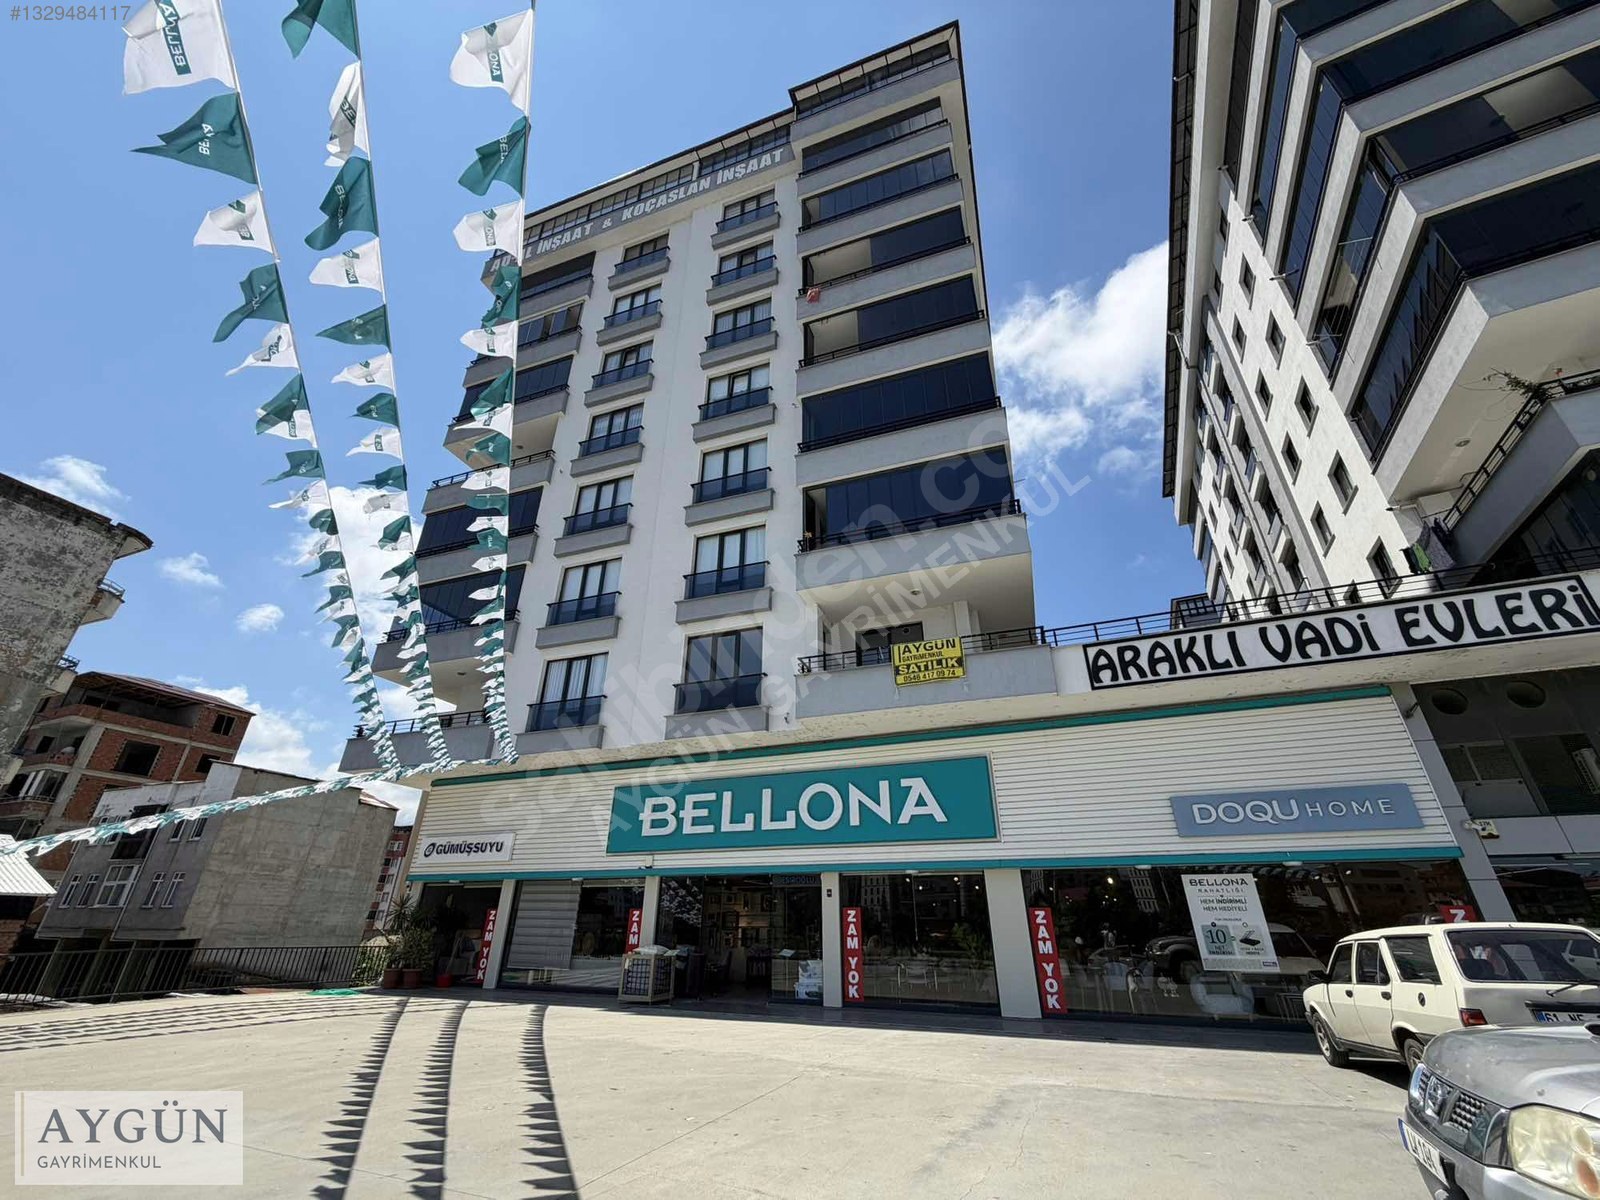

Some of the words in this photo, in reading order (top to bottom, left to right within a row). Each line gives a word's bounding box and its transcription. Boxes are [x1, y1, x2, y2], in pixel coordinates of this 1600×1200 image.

[716, 148, 784, 184] İNŞAAT
[898, 657, 960, 675] SATILIK
[1090, 629, 1247, 684] ARAKLI
[922, 671, 935, 679] 417
[639, 777, 948, 837] BELLONA
[1191, 799, 1300, 825] DOQU
[1304, 799, 1396, 817] HOME
[435, 840, 504, 856] GÜMÜŞSUYU
[1189, 878, 1248, 887] BELLONA
[484, 910, 496, 942] ZAM
[628, 910, 640, 945] ZAM
[846, 910, 859, 950] ZAM
[1034, 910, 1054, 955] ZAM
[477, 946, 489, 980] YOK
[848, 956, 860, 999] YOK
[1041, 962, 1062, 1010] YOK
